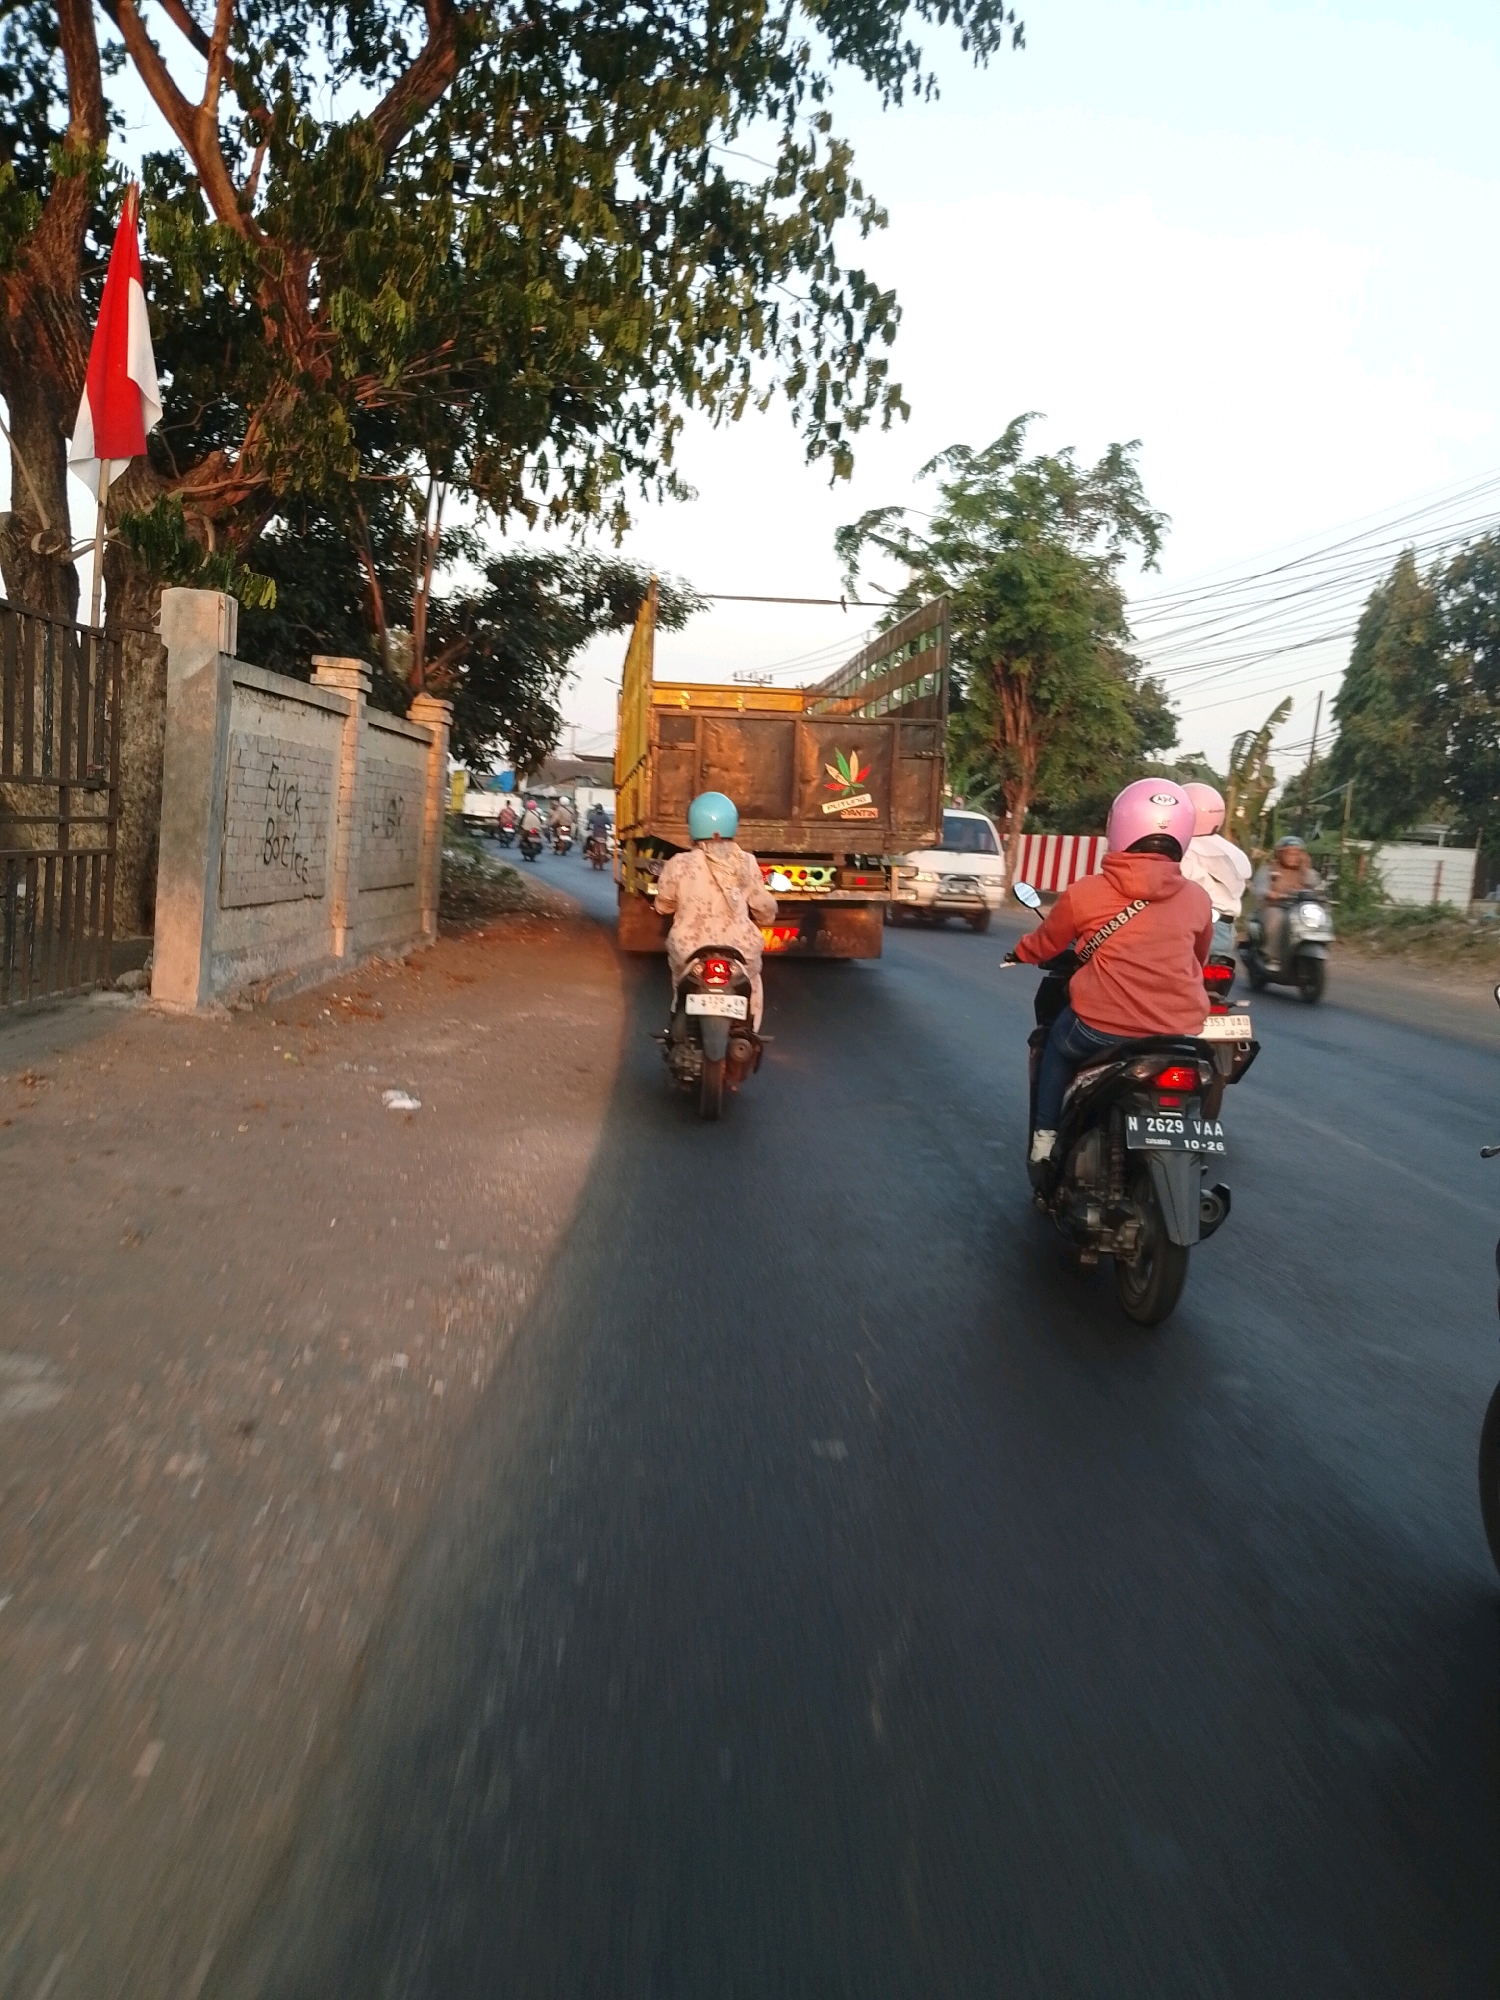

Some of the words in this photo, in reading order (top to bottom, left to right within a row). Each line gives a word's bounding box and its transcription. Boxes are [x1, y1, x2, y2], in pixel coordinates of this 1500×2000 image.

[264, 761, 302, 829] FUCK
[1128, 1116, 1138, 1131] N
[1146, 1117, 1184, 1134] 2629
[1193, 1120, 1223, 1137] VAA
